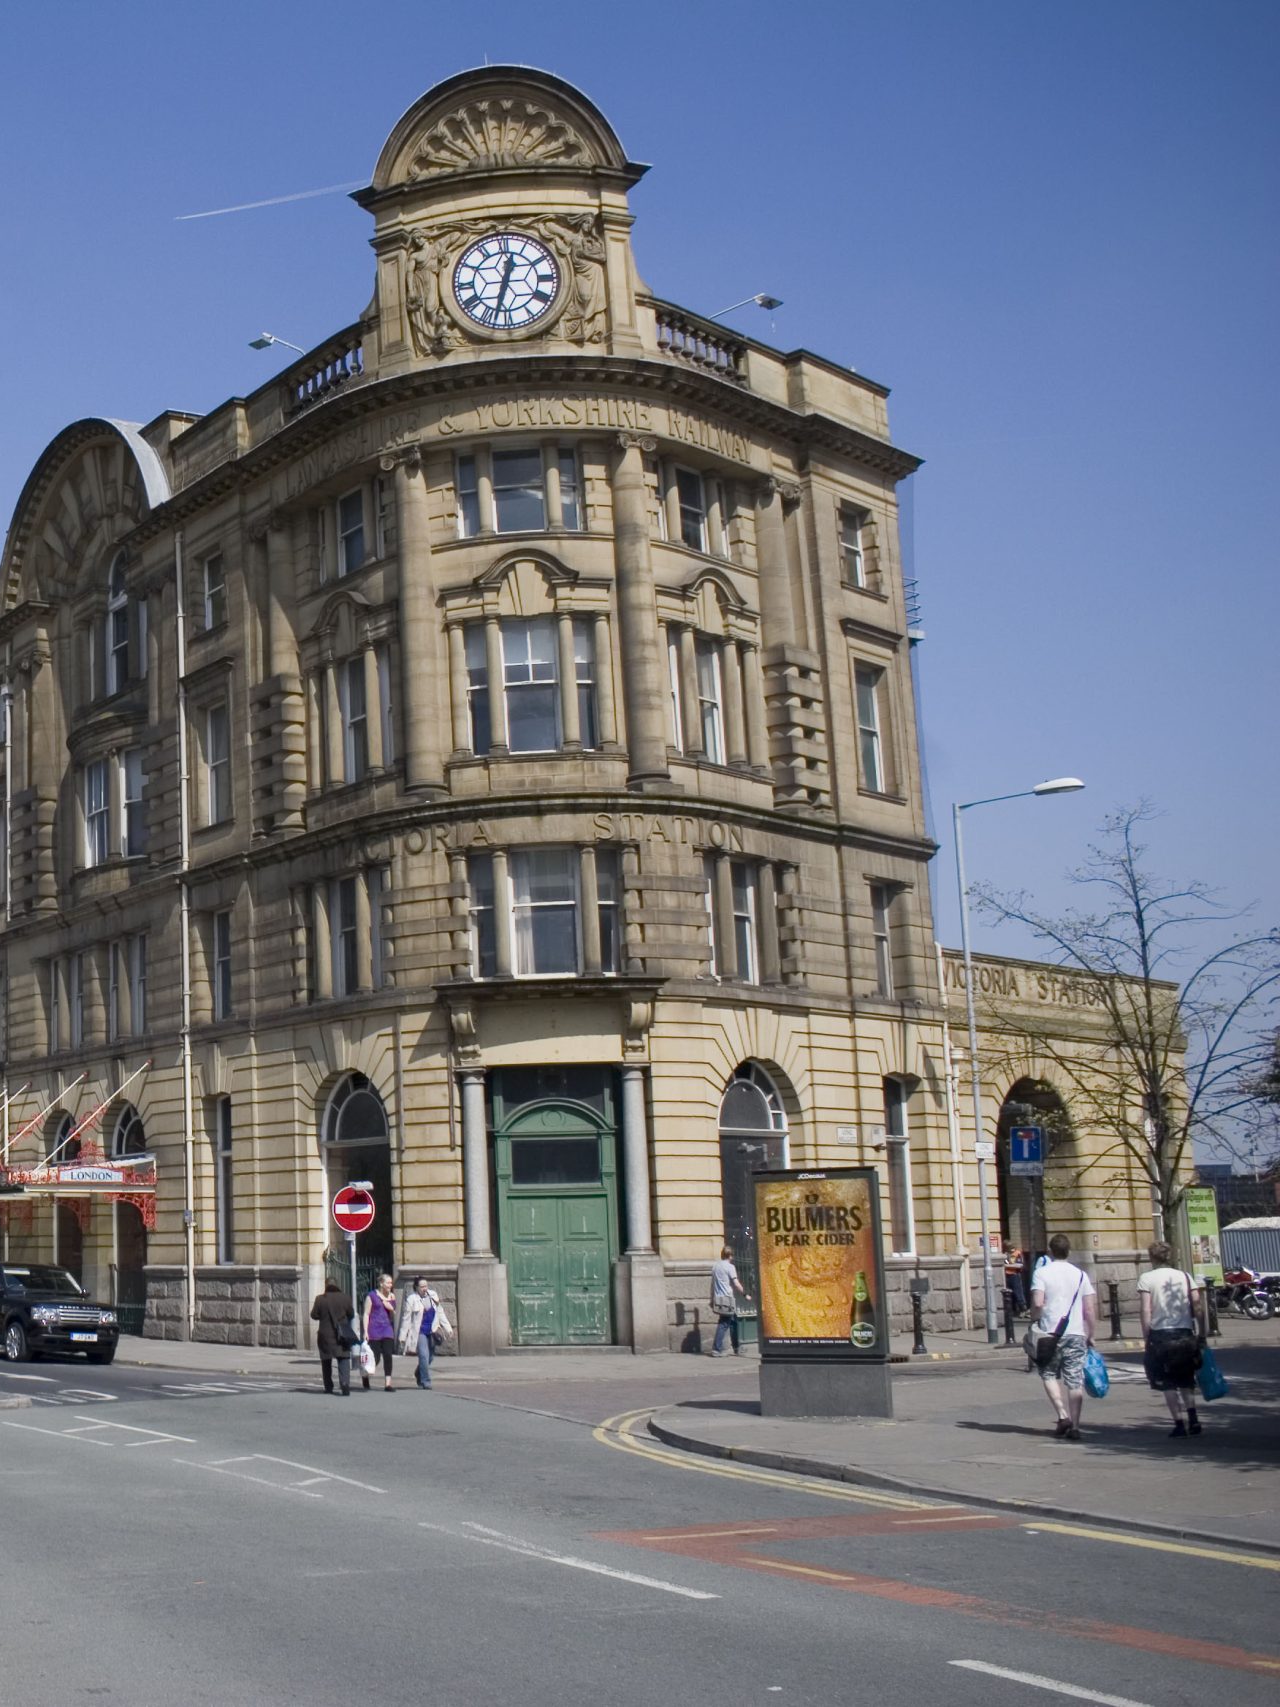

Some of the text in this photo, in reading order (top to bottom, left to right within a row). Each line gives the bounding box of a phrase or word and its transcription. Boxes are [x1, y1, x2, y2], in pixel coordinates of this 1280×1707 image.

[437, 403, 464, 435] &
[474, 392, 652, 431] YORKSHIRE
[668, 406, 752, 464] RAILWAY
[71, 1171, 112, 1180] LONDON
[766, 1206, 862, 1232] BULMERS
[775, 1233, 855, 1246] PEAR CIDER
